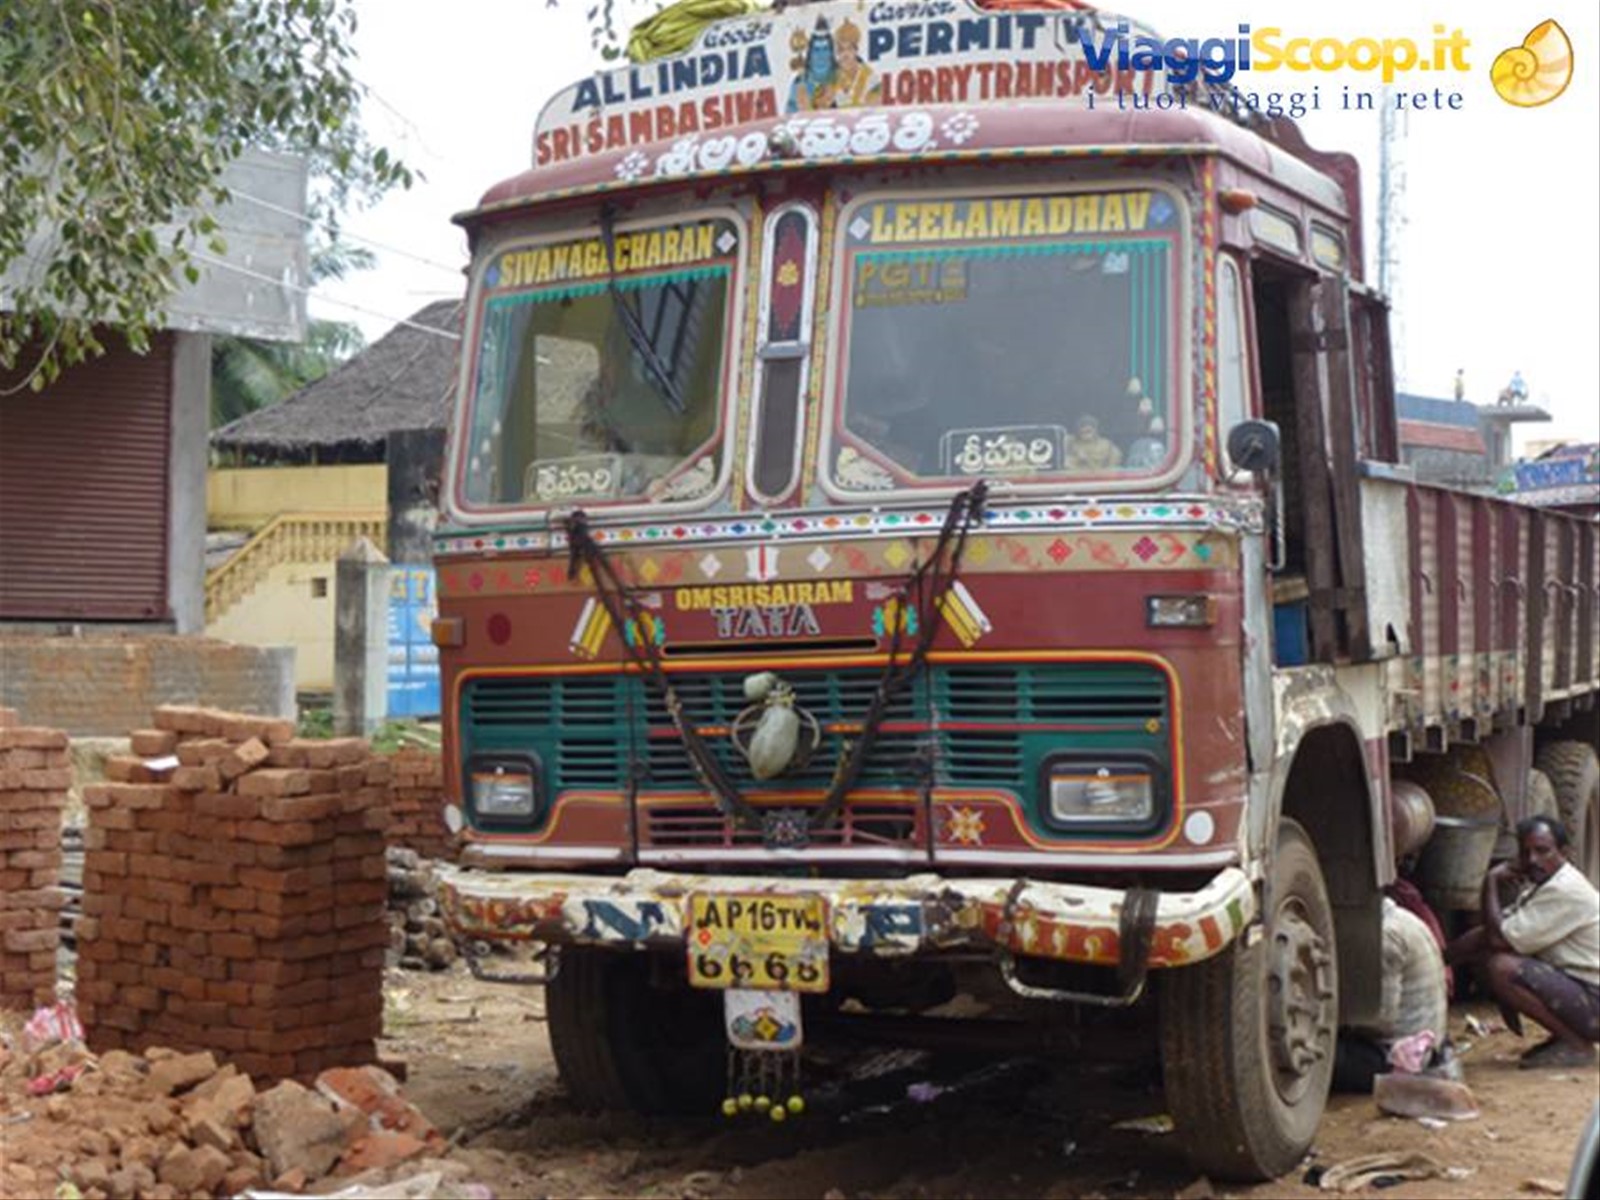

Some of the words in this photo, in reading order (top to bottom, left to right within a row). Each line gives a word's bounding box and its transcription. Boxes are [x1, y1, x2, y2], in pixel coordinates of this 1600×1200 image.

[868, 14, 1046, 62] PERMIT
[870, 191, 1150, 243] LEELAMADHAV
[613, 225, 715, 273] CHARAN
[711, 604, 821, 638] TATA
